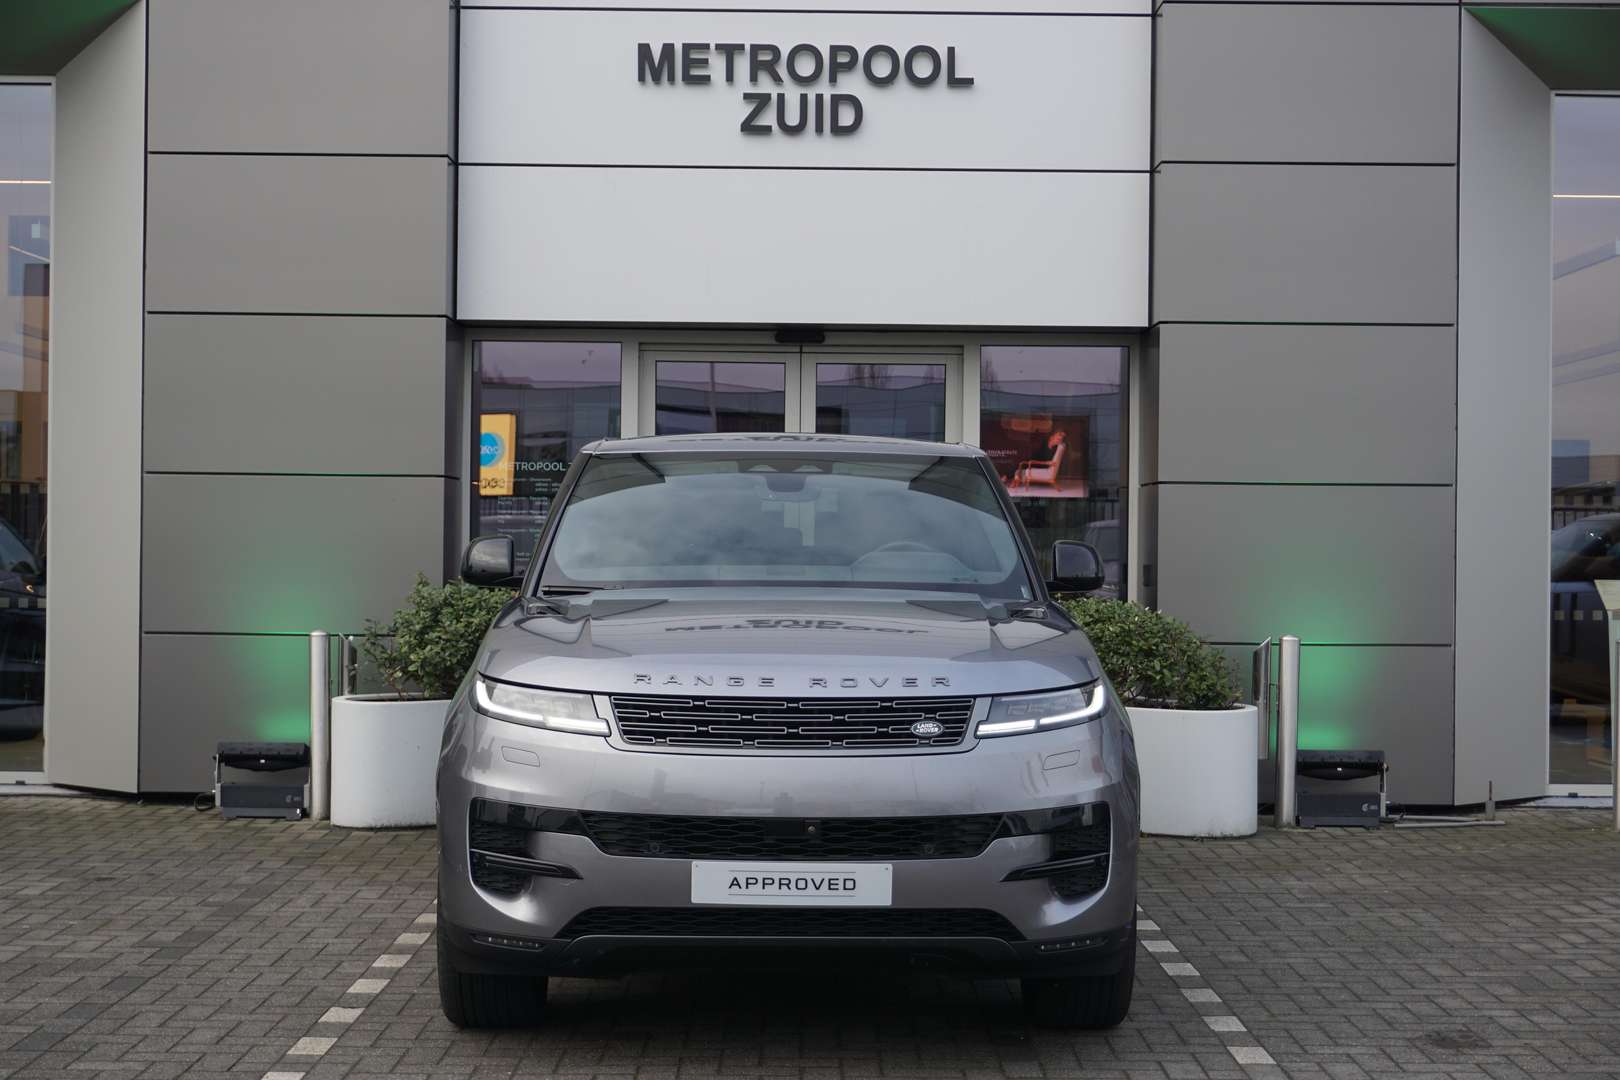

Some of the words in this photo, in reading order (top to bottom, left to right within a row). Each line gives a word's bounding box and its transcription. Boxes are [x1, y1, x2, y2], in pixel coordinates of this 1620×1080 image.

[637, 43, 975, 85] METROPOOL
[740, 92, 863, 134] ZUID
[633, 673, 776, 687] RANGE
[809, 676, 951, 688] ROVER
[728, 876, 857, 891] APPROVED
